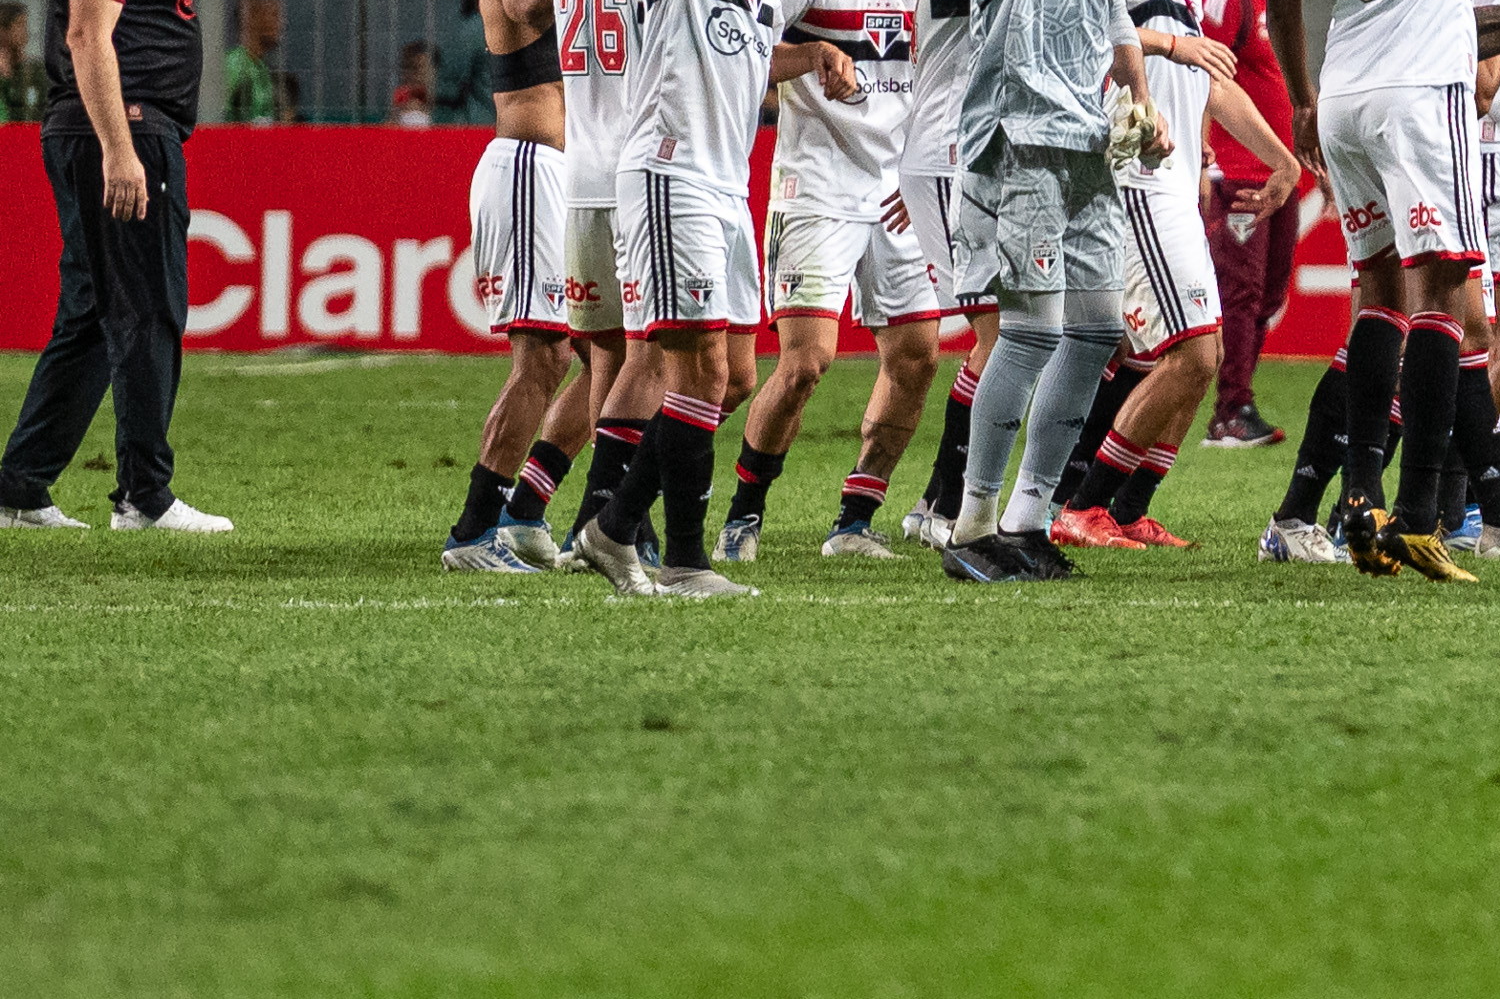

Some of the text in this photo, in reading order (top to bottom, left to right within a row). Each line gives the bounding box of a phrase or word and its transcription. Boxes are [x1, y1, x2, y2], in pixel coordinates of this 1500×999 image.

[867, 17, 900, 29] SPFC
[1343, 201, 1386, 233] abc
[1409, 201, 1442, 229] abc
